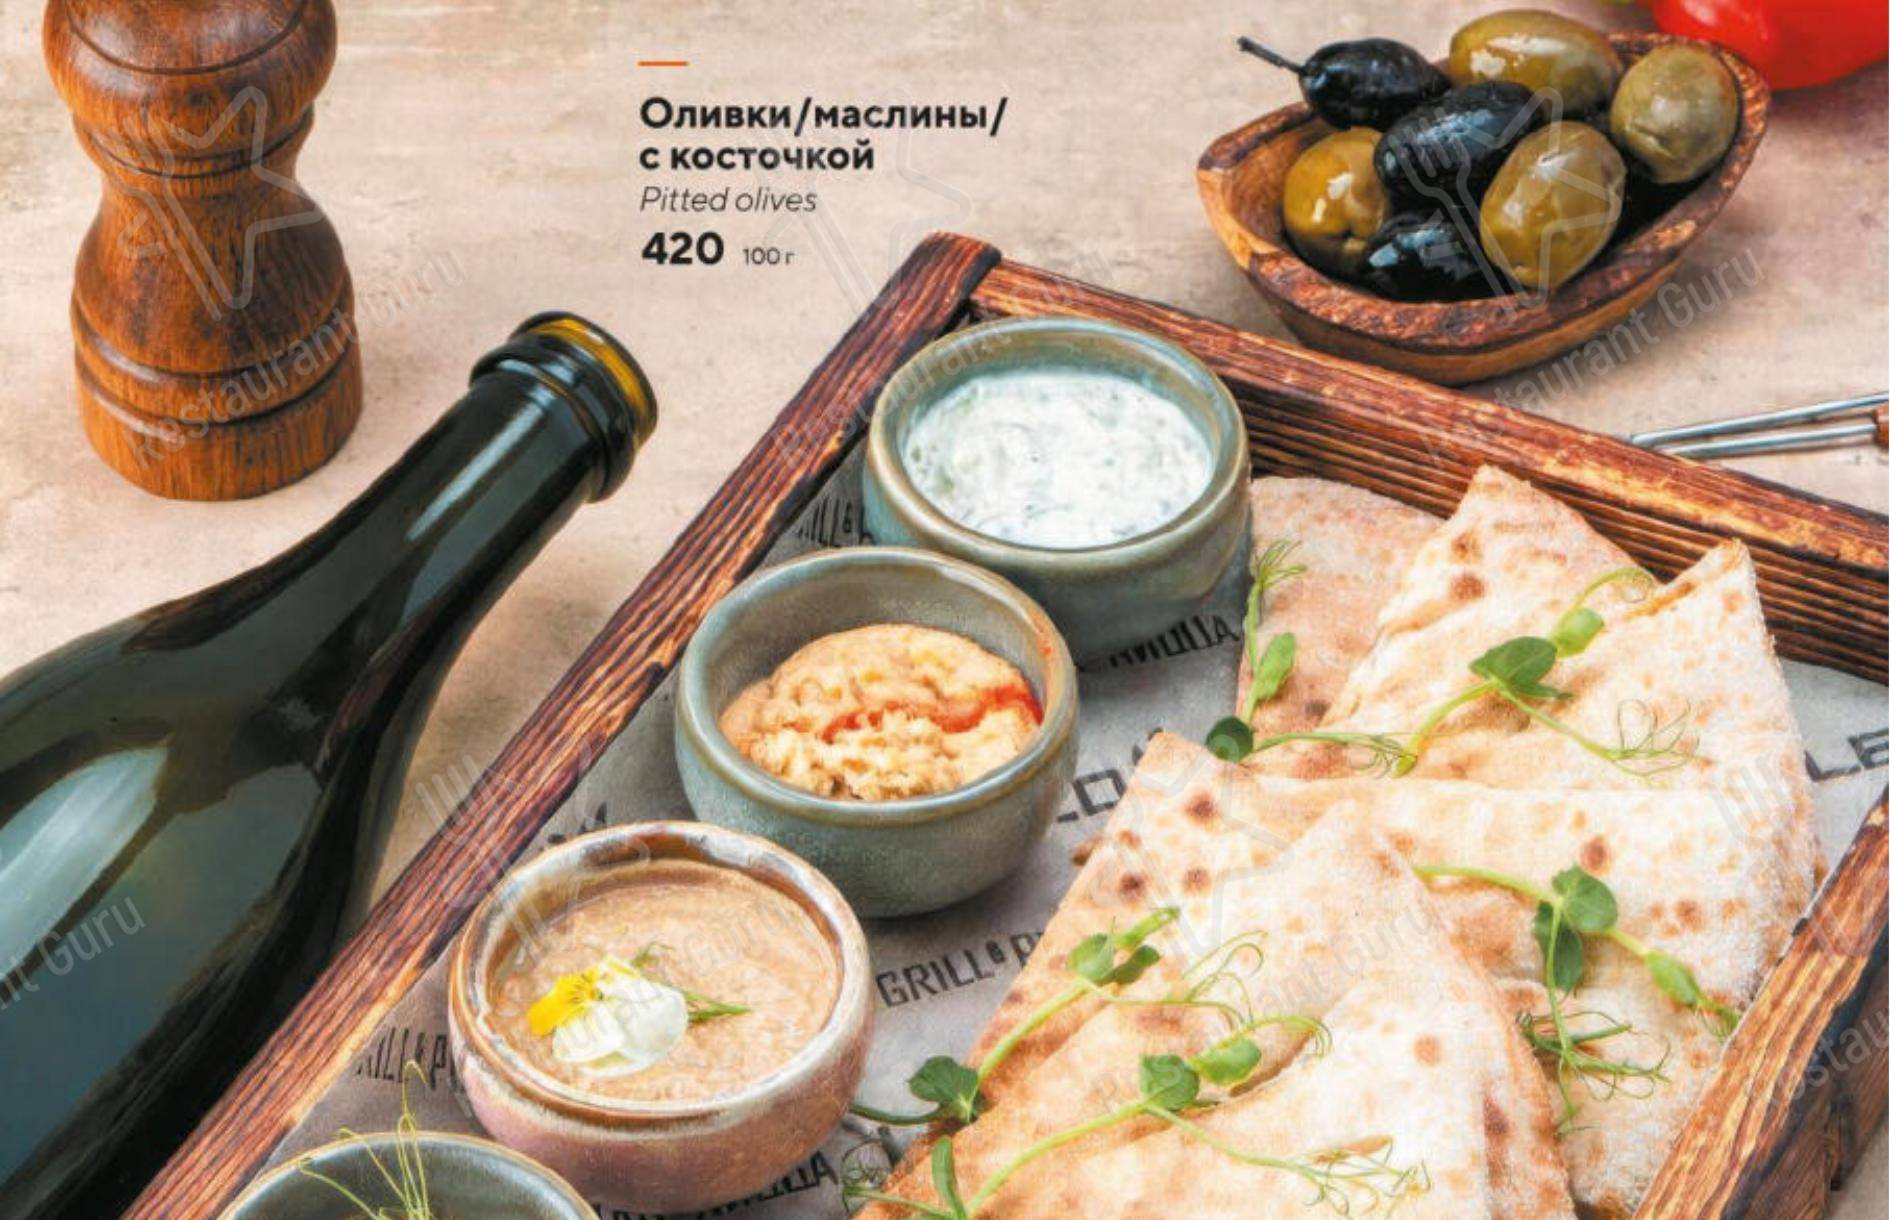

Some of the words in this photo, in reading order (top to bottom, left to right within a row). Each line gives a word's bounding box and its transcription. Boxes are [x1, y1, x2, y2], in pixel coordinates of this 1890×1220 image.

[638, 146, 661, 171] с
[670, 138, 875, 171] косточкой
[639, 185, 731, 213] Pitted
[734, 186, 818, 213] olives
[641, 230, 725, 266] 420
[742, 246, 781, 266] 100
[784, 251, 796, 266] г
[874, 948, 995, 1008] GRILL
